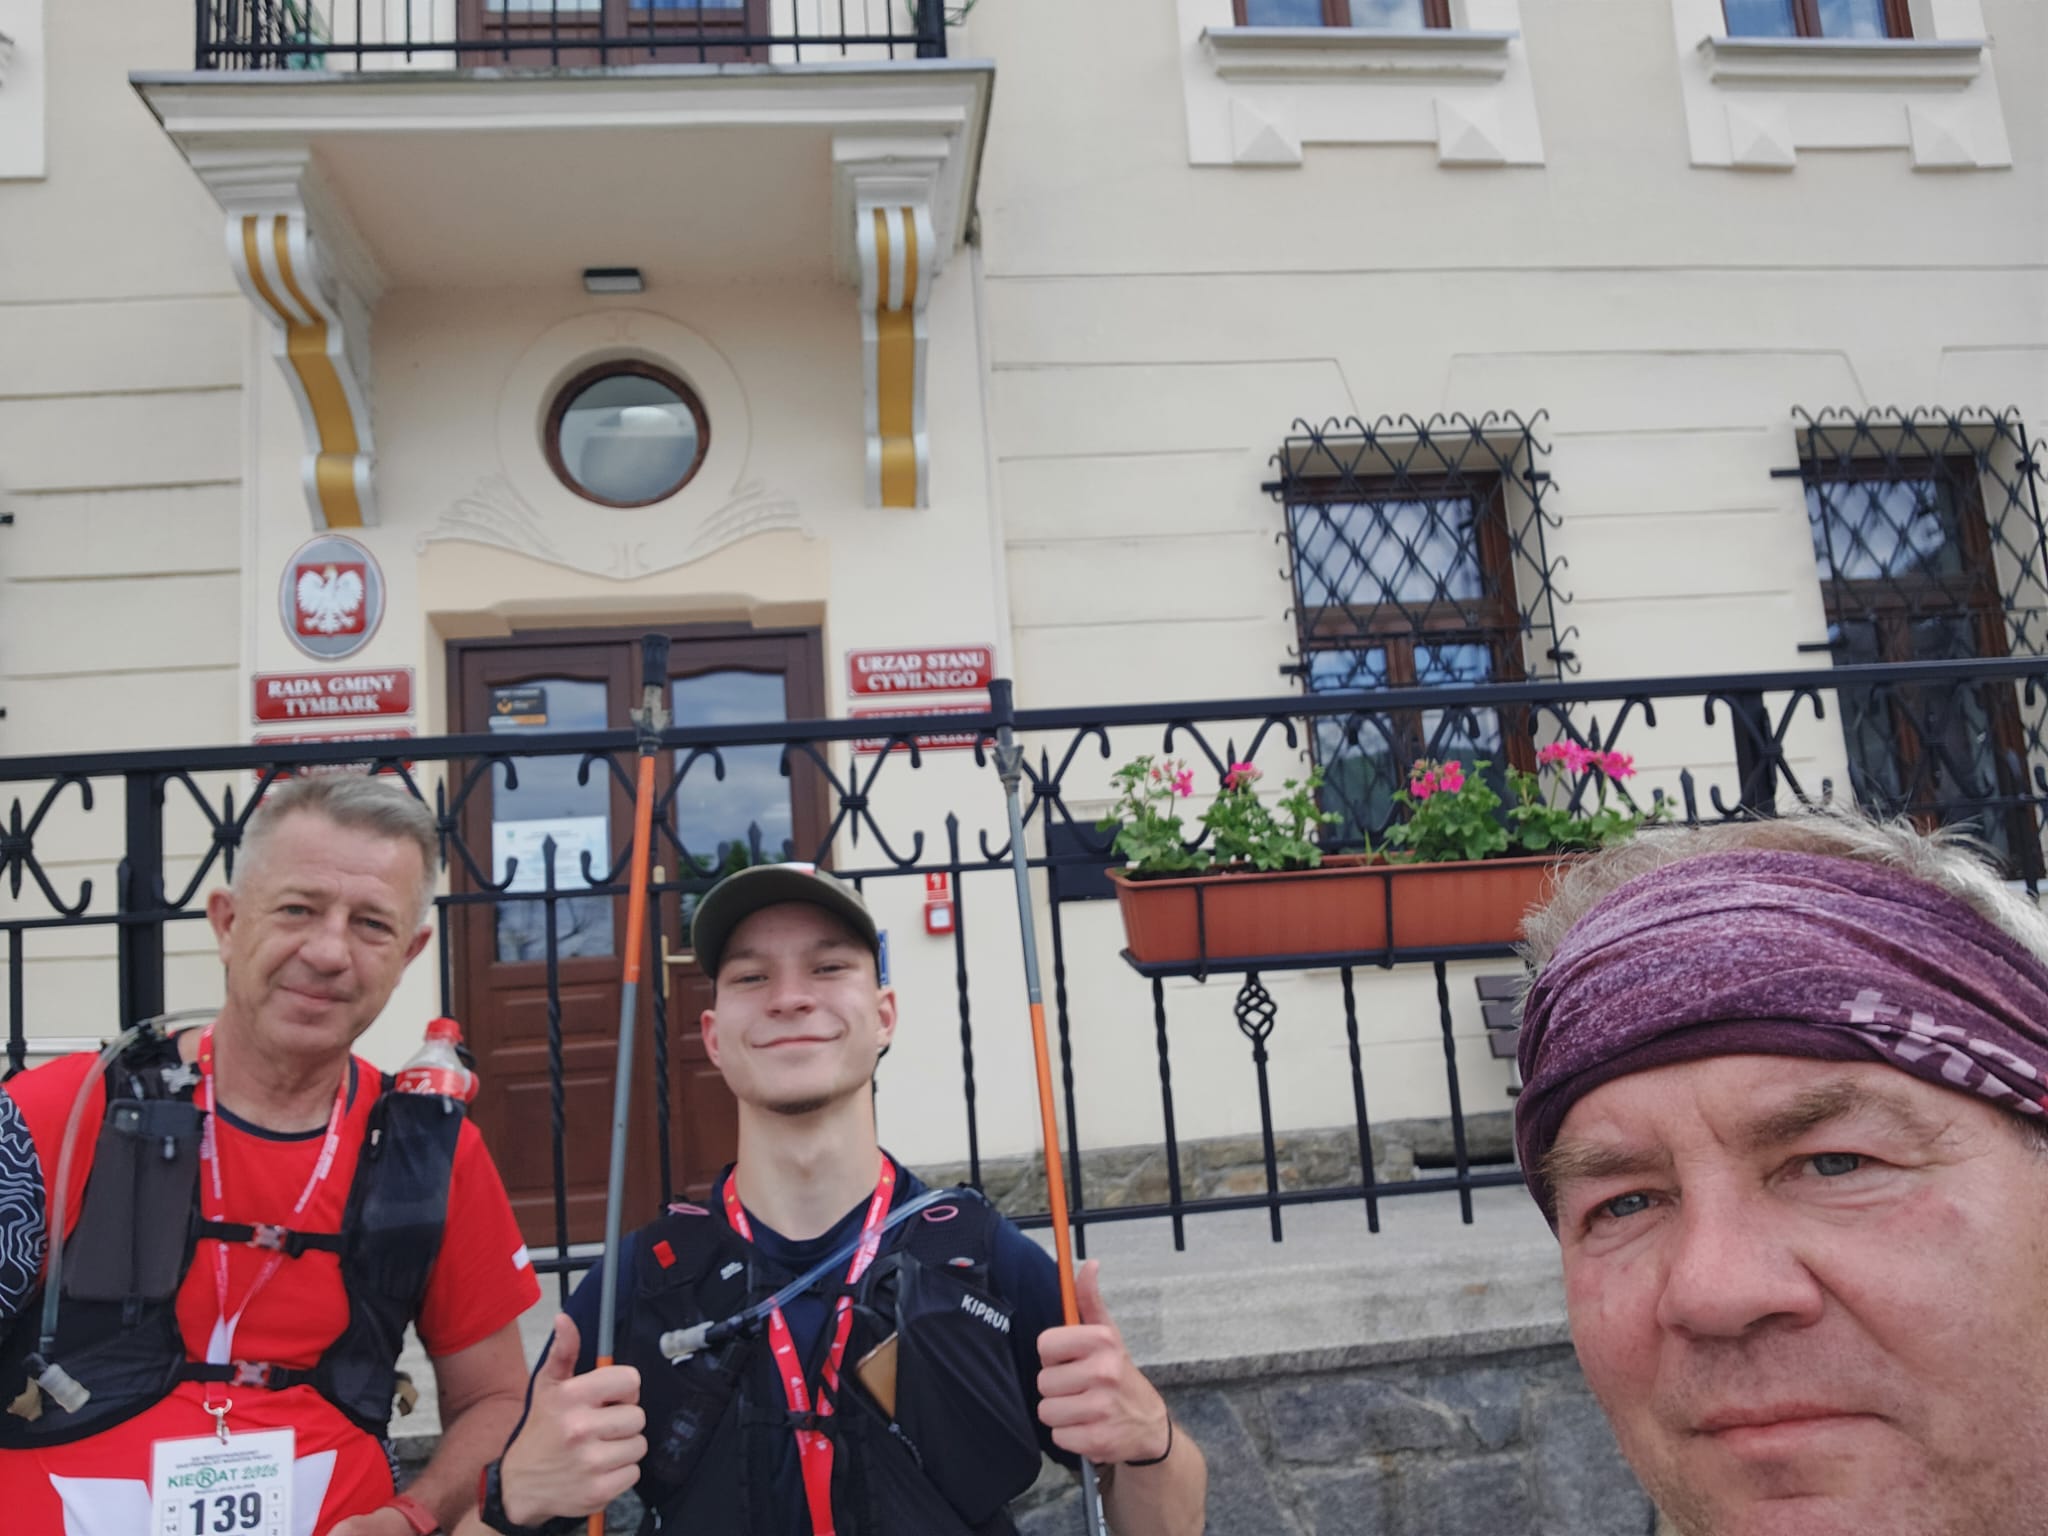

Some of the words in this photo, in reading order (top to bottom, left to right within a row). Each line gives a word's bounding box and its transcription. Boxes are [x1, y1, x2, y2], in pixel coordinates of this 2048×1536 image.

[926, 652, 985, 670] STANU
[268, 679, 322, 697] RADA
[327, 675, 396, 694] GMINY
[867, 670, 978, 690] CYWILNEGO
[283, 695, 379, 715] TYMBARK
[961, 1294, 1010, 1334] KIPRUN
[168, 1467, 238, 1488] KIERAT
[189, 1492, 262, 1535] 139
